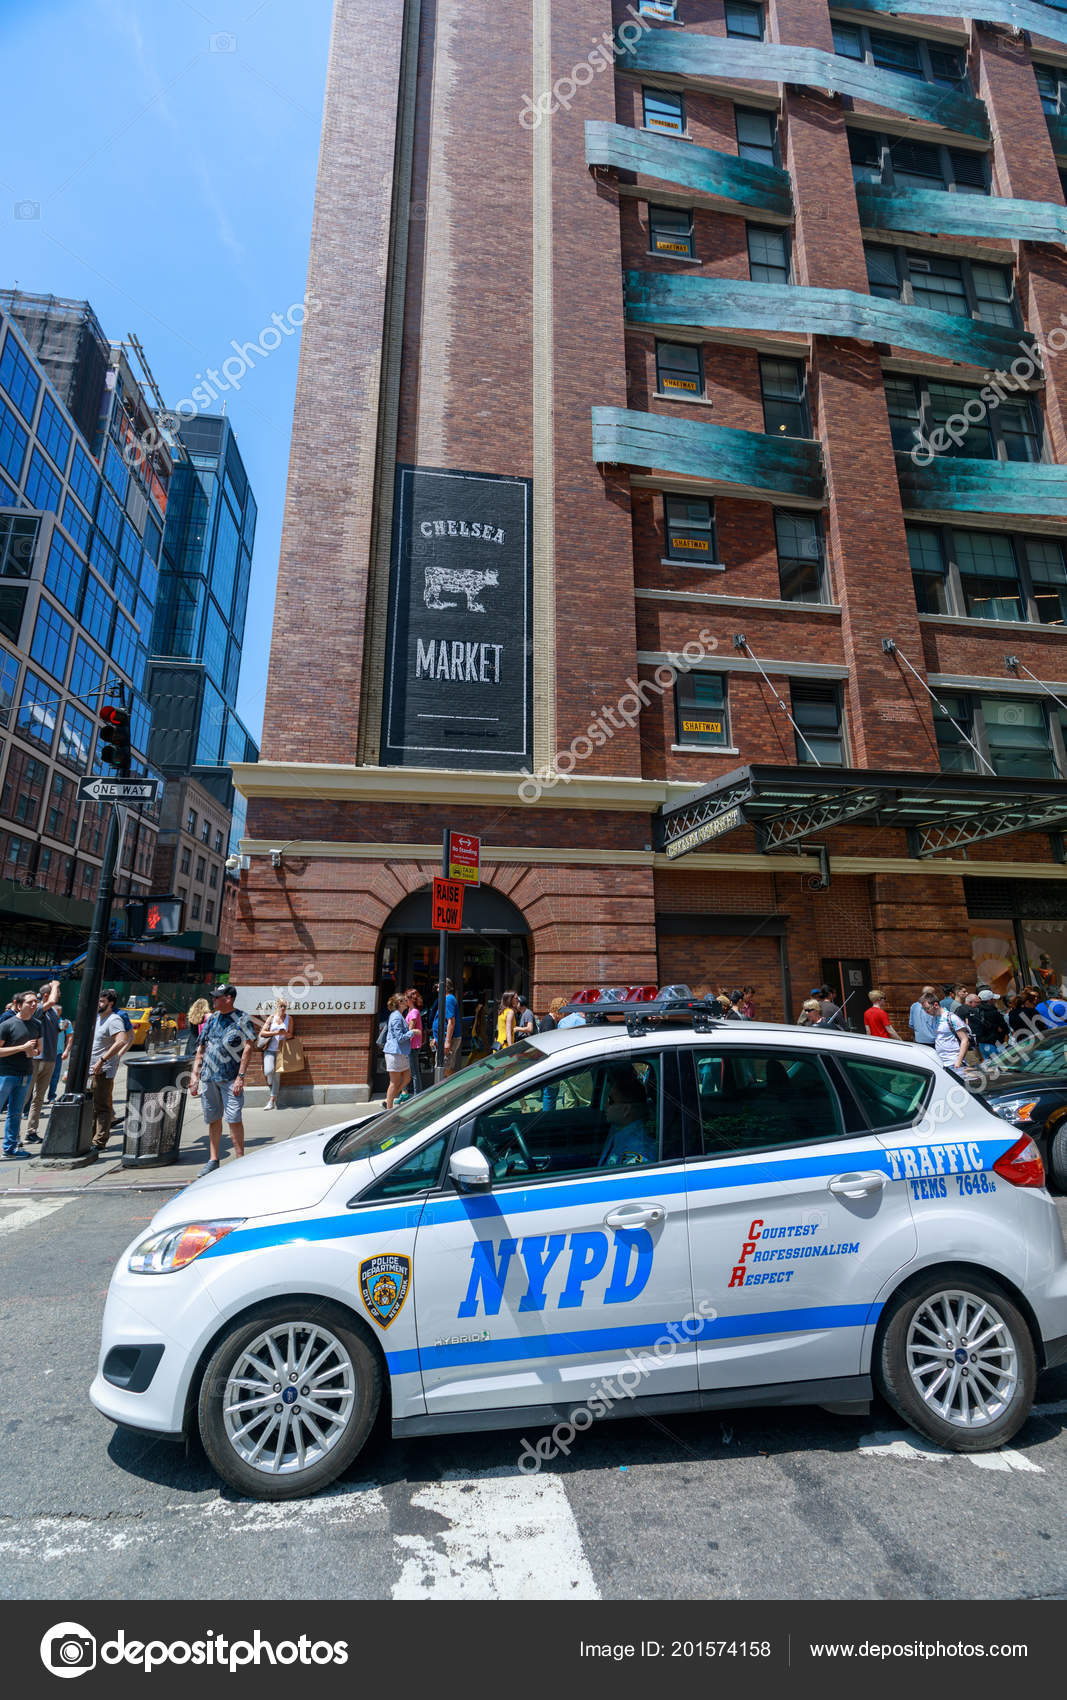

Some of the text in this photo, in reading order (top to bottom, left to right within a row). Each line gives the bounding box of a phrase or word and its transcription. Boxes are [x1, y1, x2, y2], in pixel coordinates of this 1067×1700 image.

[420, 520, 505, 545] CHELSEA
[415, 638, 504, 684] MARKET
[685, 722, 719, 732] SHAFTWAY
[93, 784, 146, 796] ONE WAY
[437, 884, 459, 902] RAISE
[437, 907, 458, 925] PLOW
[256, 1001, 366, 1011] ANROPOLOGIE
[885, 1142, 984, 1180] TRAFFIC
[910, 1177, 948, 1201] TEMS
[371, 1257, 399, 1267] POLICE
[362, 1264, 408, 1280] DEPARTMENT
[457, 1227, 655, 1319] NYPD
[399, 1280, 408, 1299] YORK
[363, 1289, 380, 1318] CITY OF
[433, 1333, 480, 1347] HYBRID
